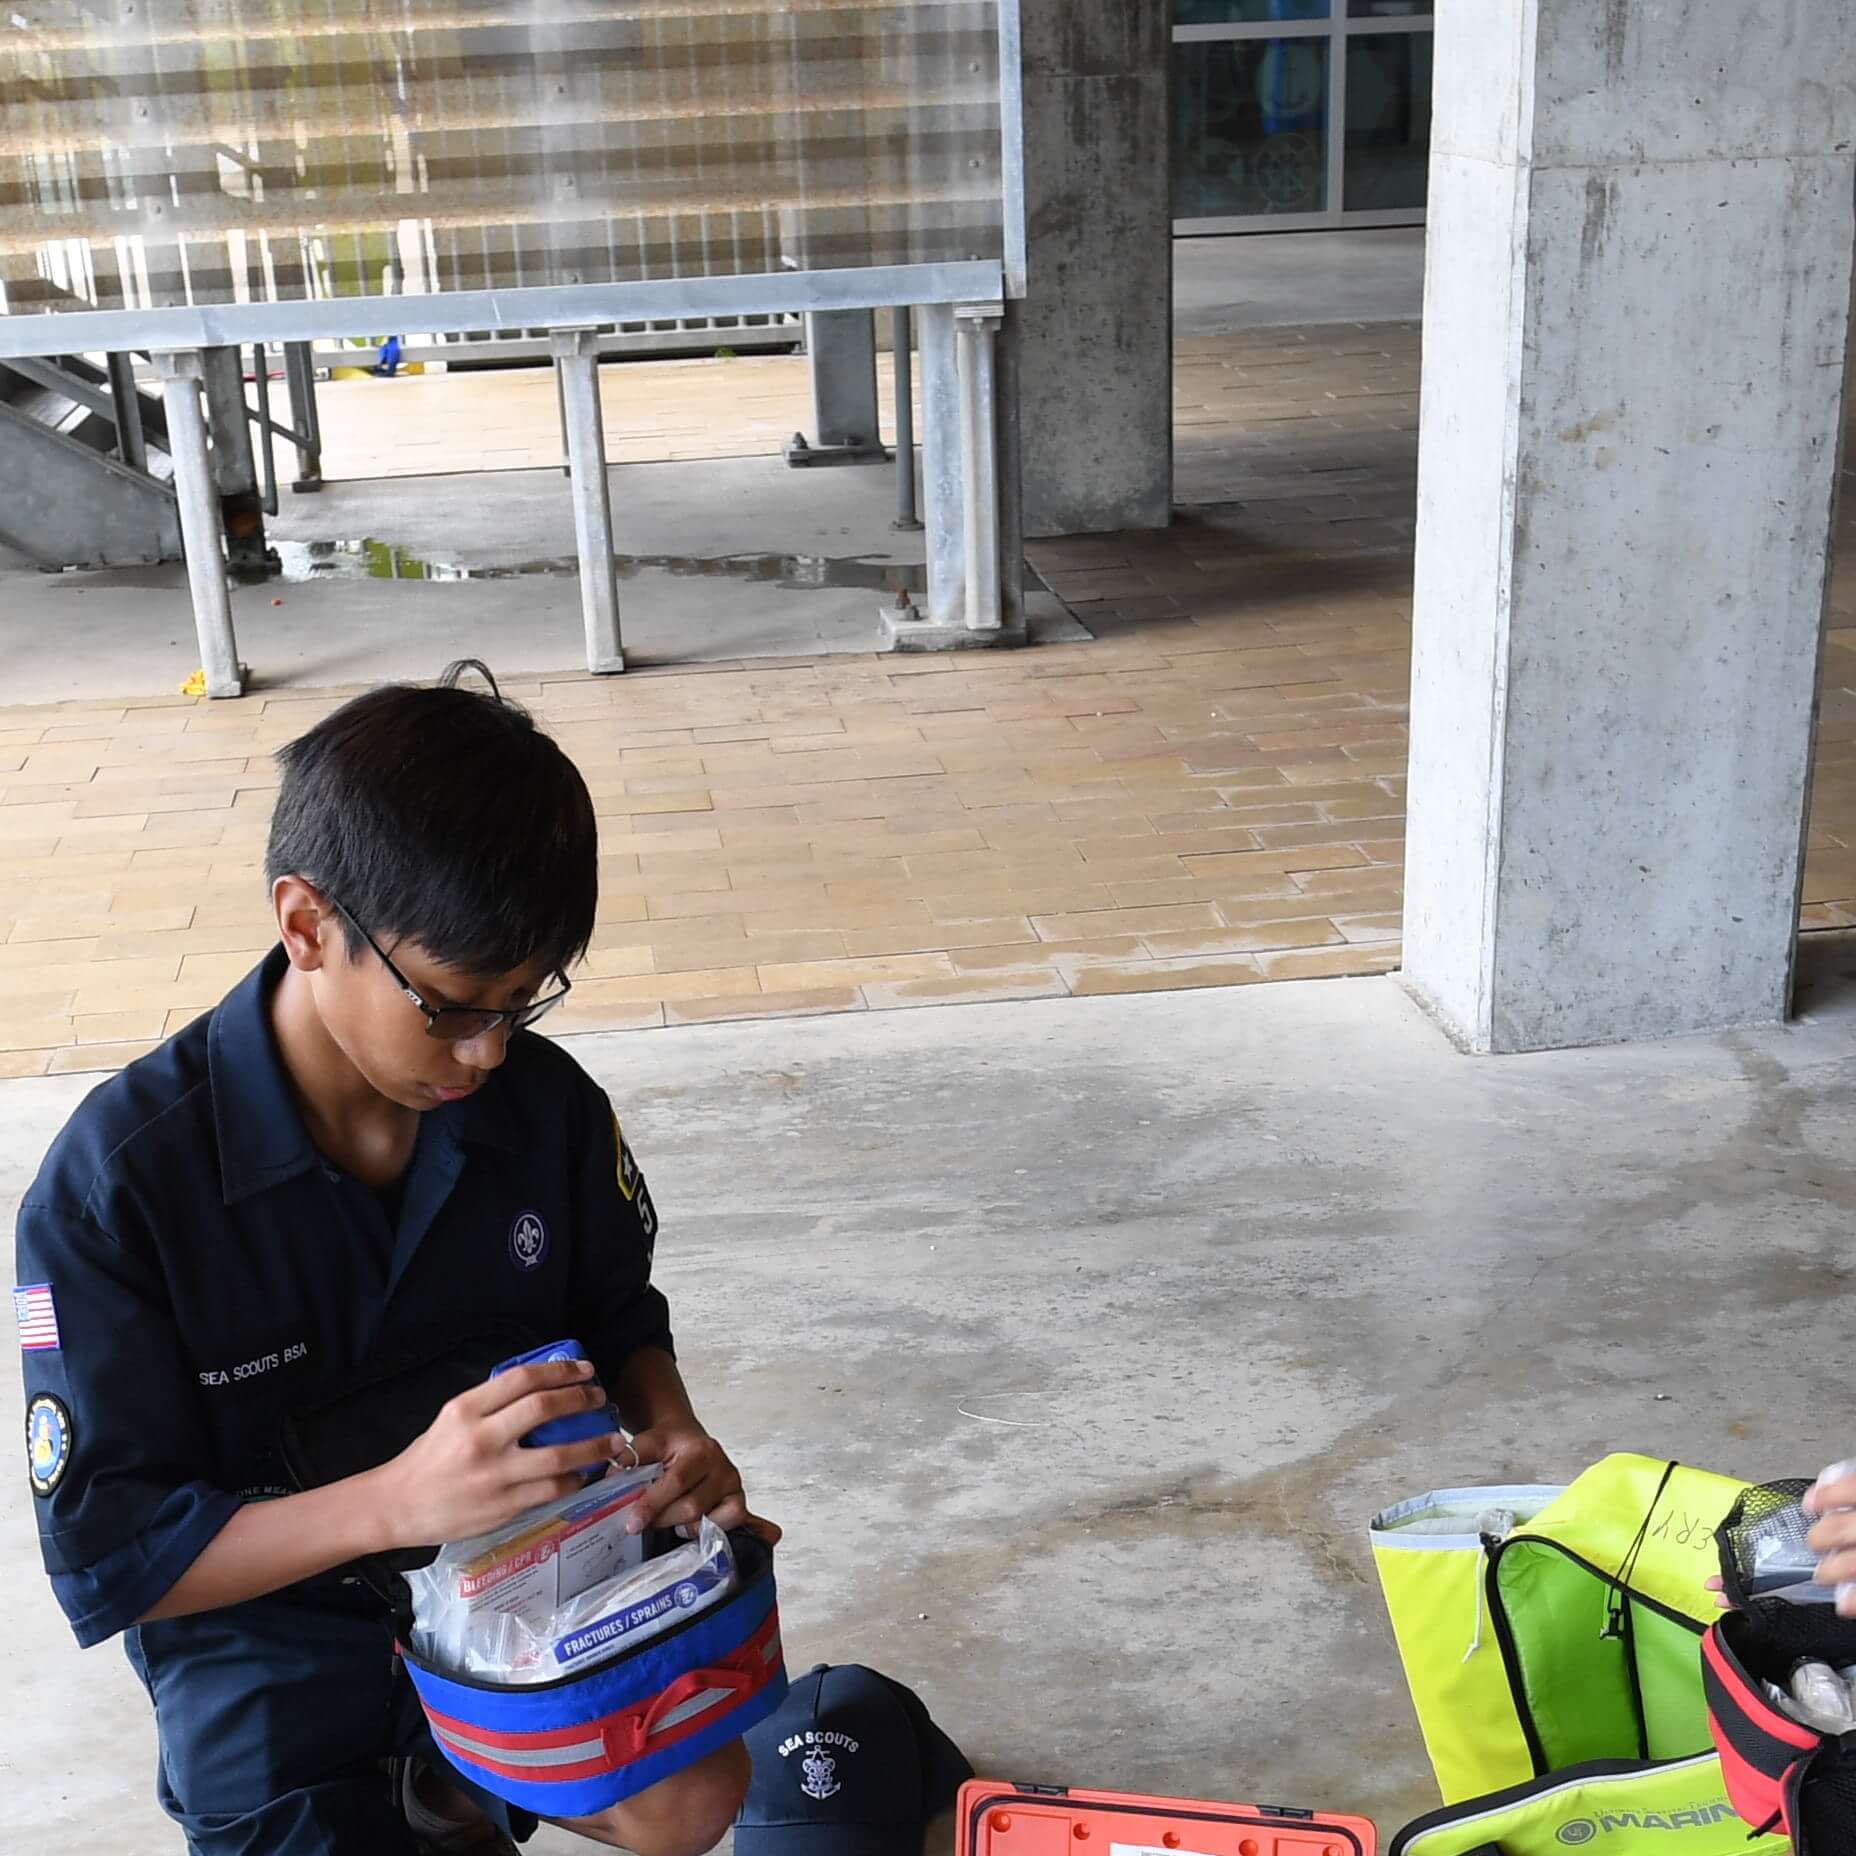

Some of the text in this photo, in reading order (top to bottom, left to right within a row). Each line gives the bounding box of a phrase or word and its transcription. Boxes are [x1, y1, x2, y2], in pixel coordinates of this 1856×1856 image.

[199, 1342, 307, 1386] SEA SCOUTS BSA
[564, 1619, 624, 1657] FRACTURES
[631, 1594, 673, 1626] SPRAINS
[778, 1731, 859, 1757] SEA SCOUTS
[1600, 1803, 1740, 1833] MARIN
